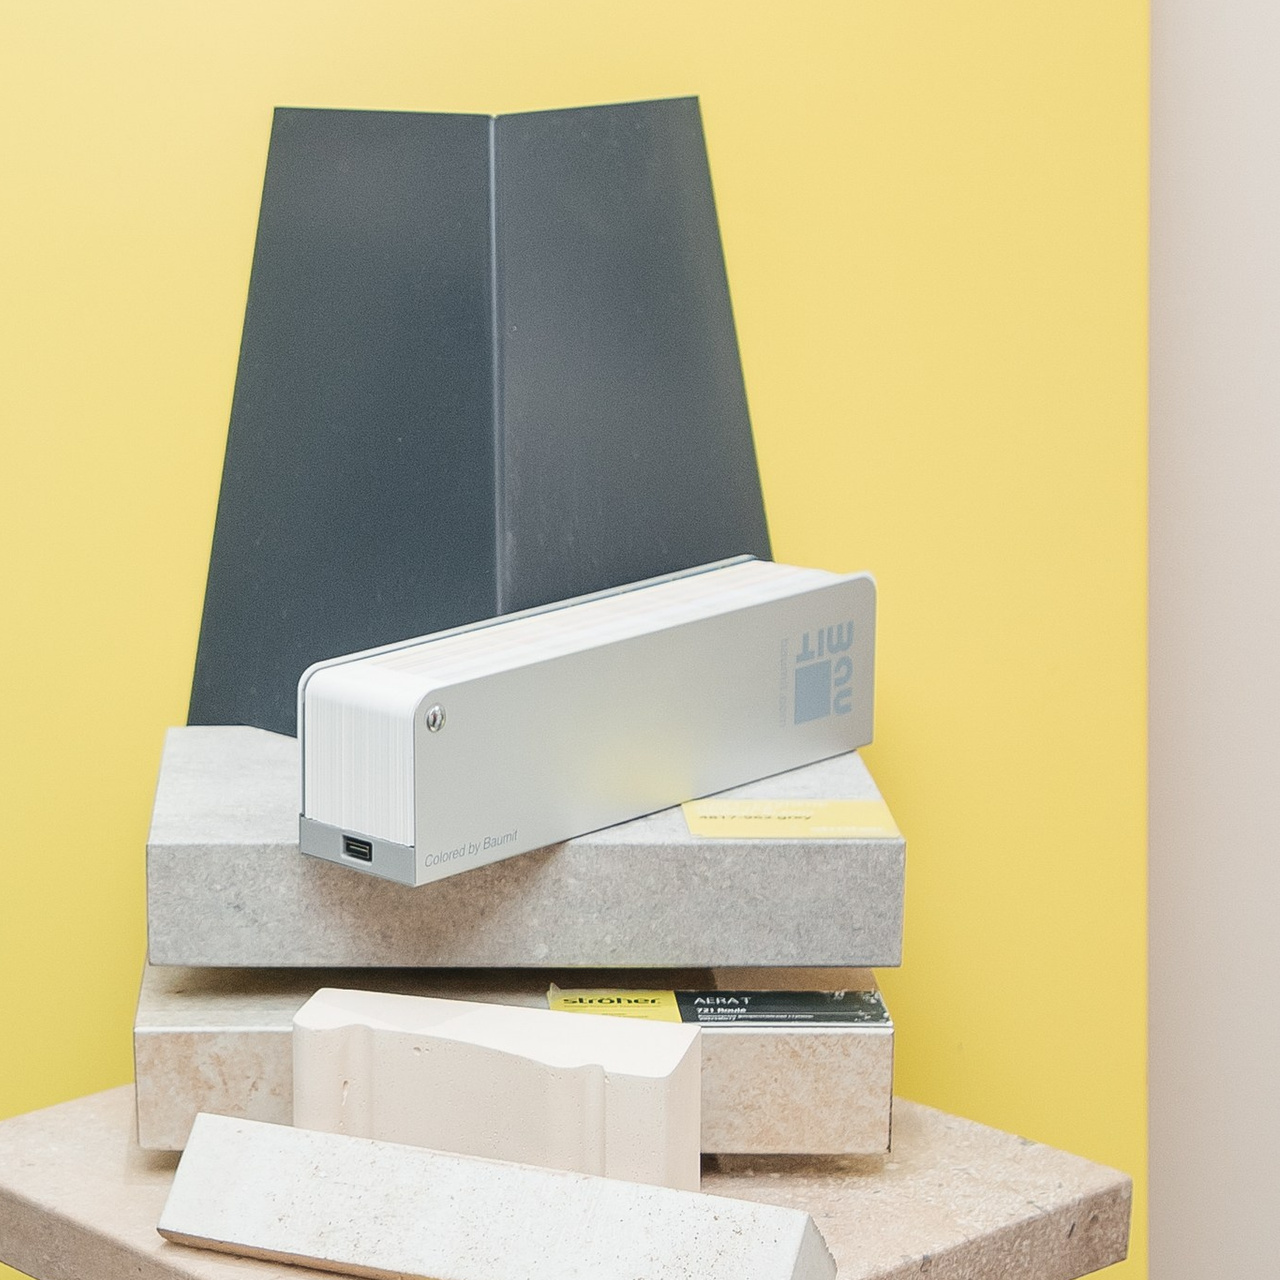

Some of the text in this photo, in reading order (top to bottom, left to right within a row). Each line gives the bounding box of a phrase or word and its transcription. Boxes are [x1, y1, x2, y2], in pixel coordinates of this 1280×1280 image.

[424, 829, 519, 868] Colored by Baumit
